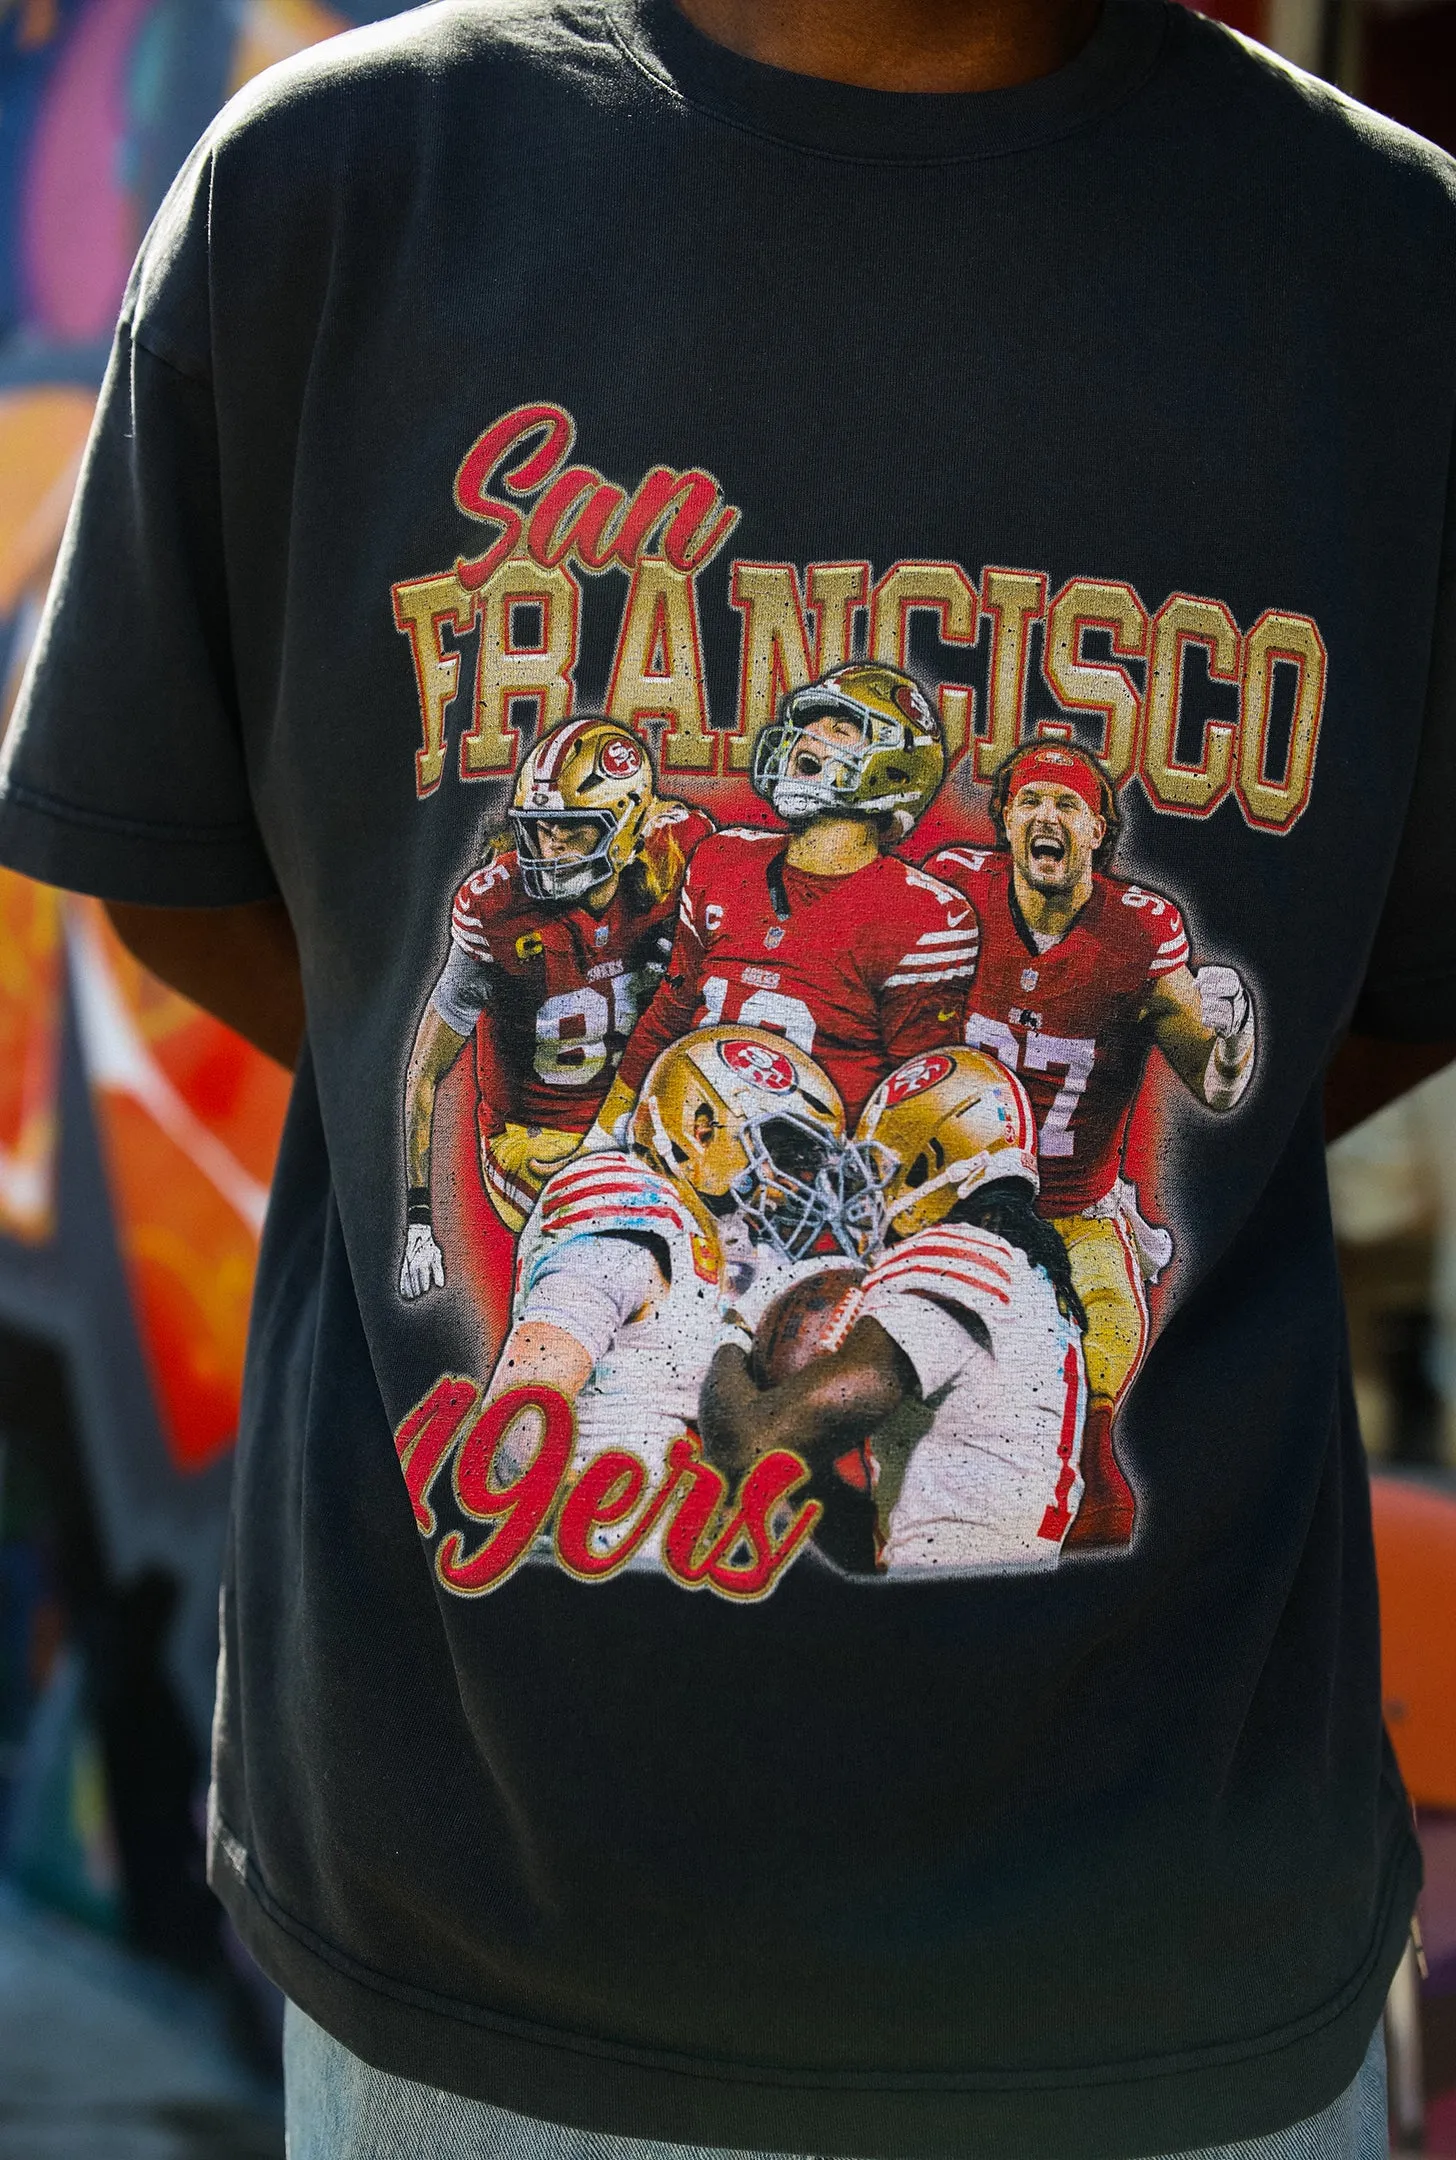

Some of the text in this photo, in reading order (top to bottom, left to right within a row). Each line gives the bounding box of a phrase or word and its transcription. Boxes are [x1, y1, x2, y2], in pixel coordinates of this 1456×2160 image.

[454, 402, 741, 591] San
[391, 557, 1328, 834] FRANCISCO
[515, 930, 544, 960] C
[706, 903, 724, 931] C
